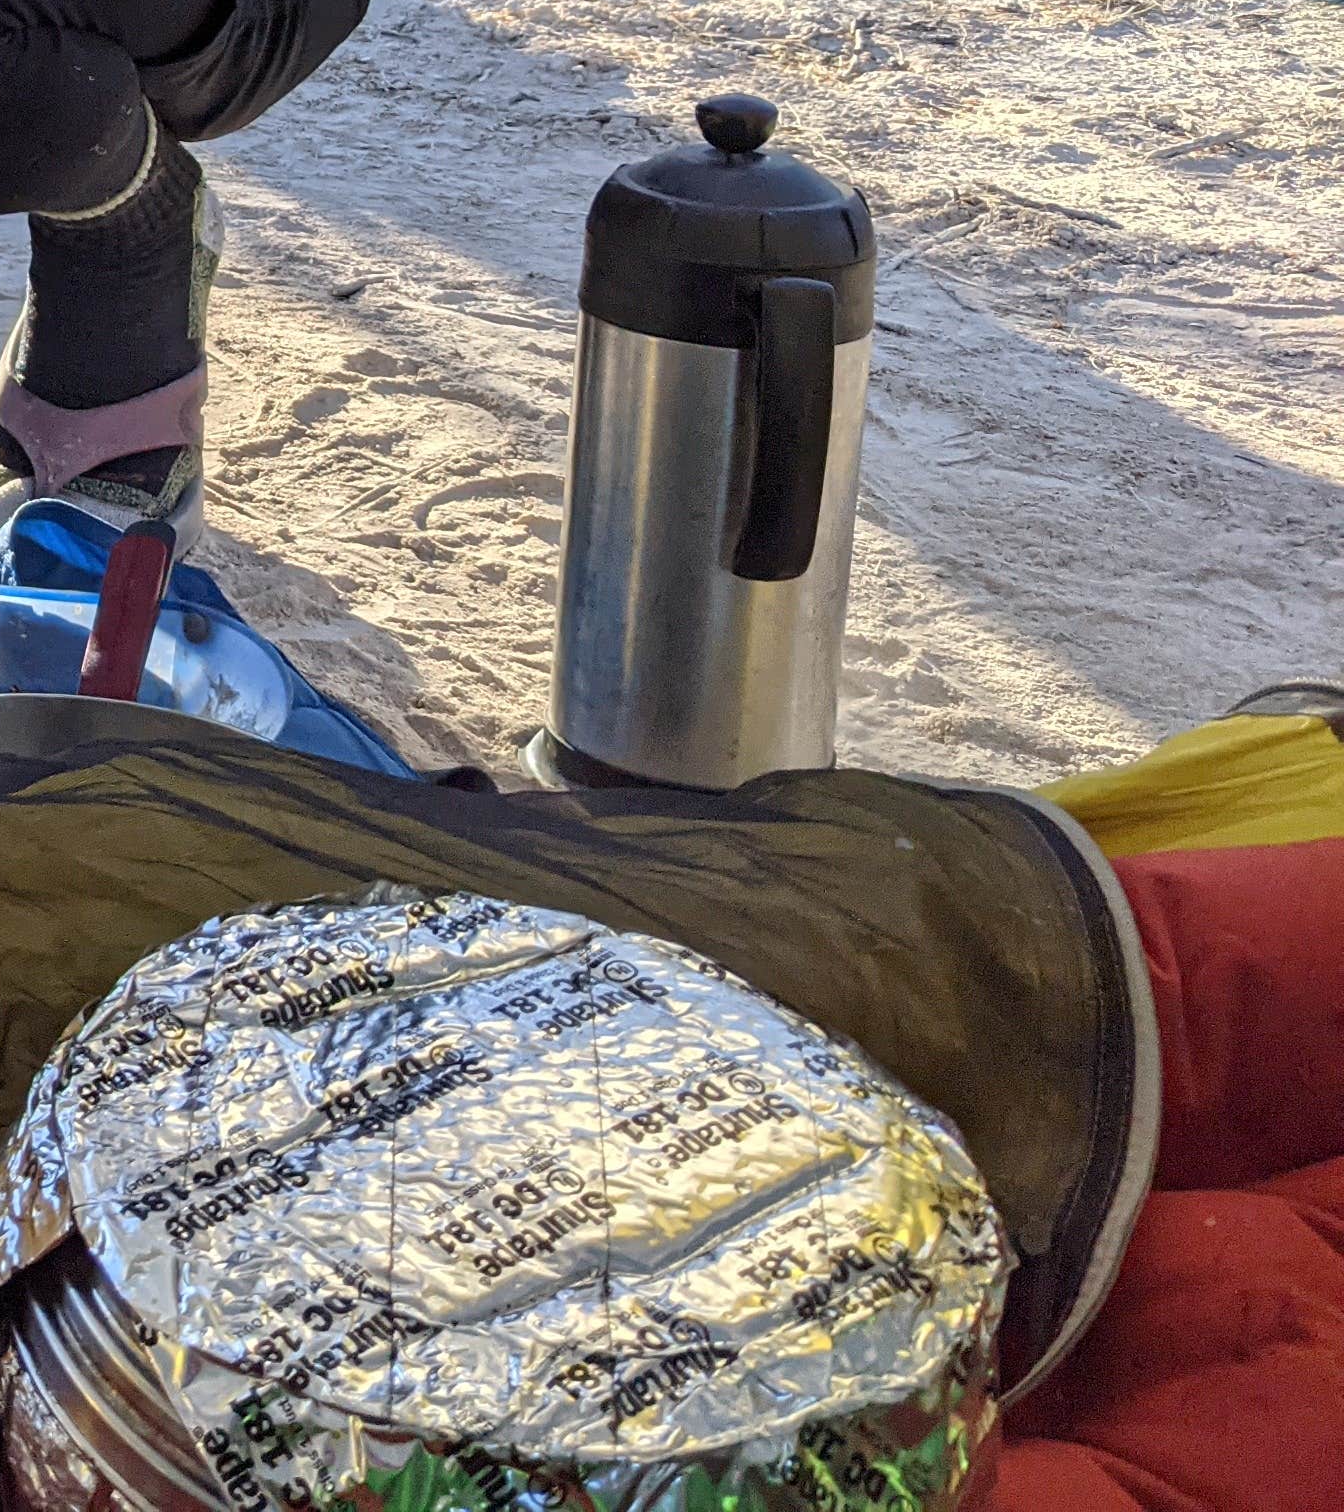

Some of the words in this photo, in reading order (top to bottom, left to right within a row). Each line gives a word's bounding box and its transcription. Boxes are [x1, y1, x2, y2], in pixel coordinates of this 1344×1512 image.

[488, 985, 554, 1023] 181
[531, 975, 668, 1036] Shurtape
[317, 1081, 374, 1125] 181
[677, 1080, 730, 1116] DC
[610, 1101, 678, 1144] 181
[661, 1093, 799, 1164] Shurtape
[118, 1181, 189, 1223] 181
[165, 1164, 310, 1243] Shurtape
[463, 1176, 494, 1199] Class
[492, 1181, 548, 1221] DC
[418, 1209, 497, 1259] 181
[472, 1191, 618, 1279] Shurtape
[737, 1247, 810, 1292] 181
[273, 1285, 306, 1314] Class
[301, 1293, 357, 1332] DC
[229, 1388, 297, 1471] 181
